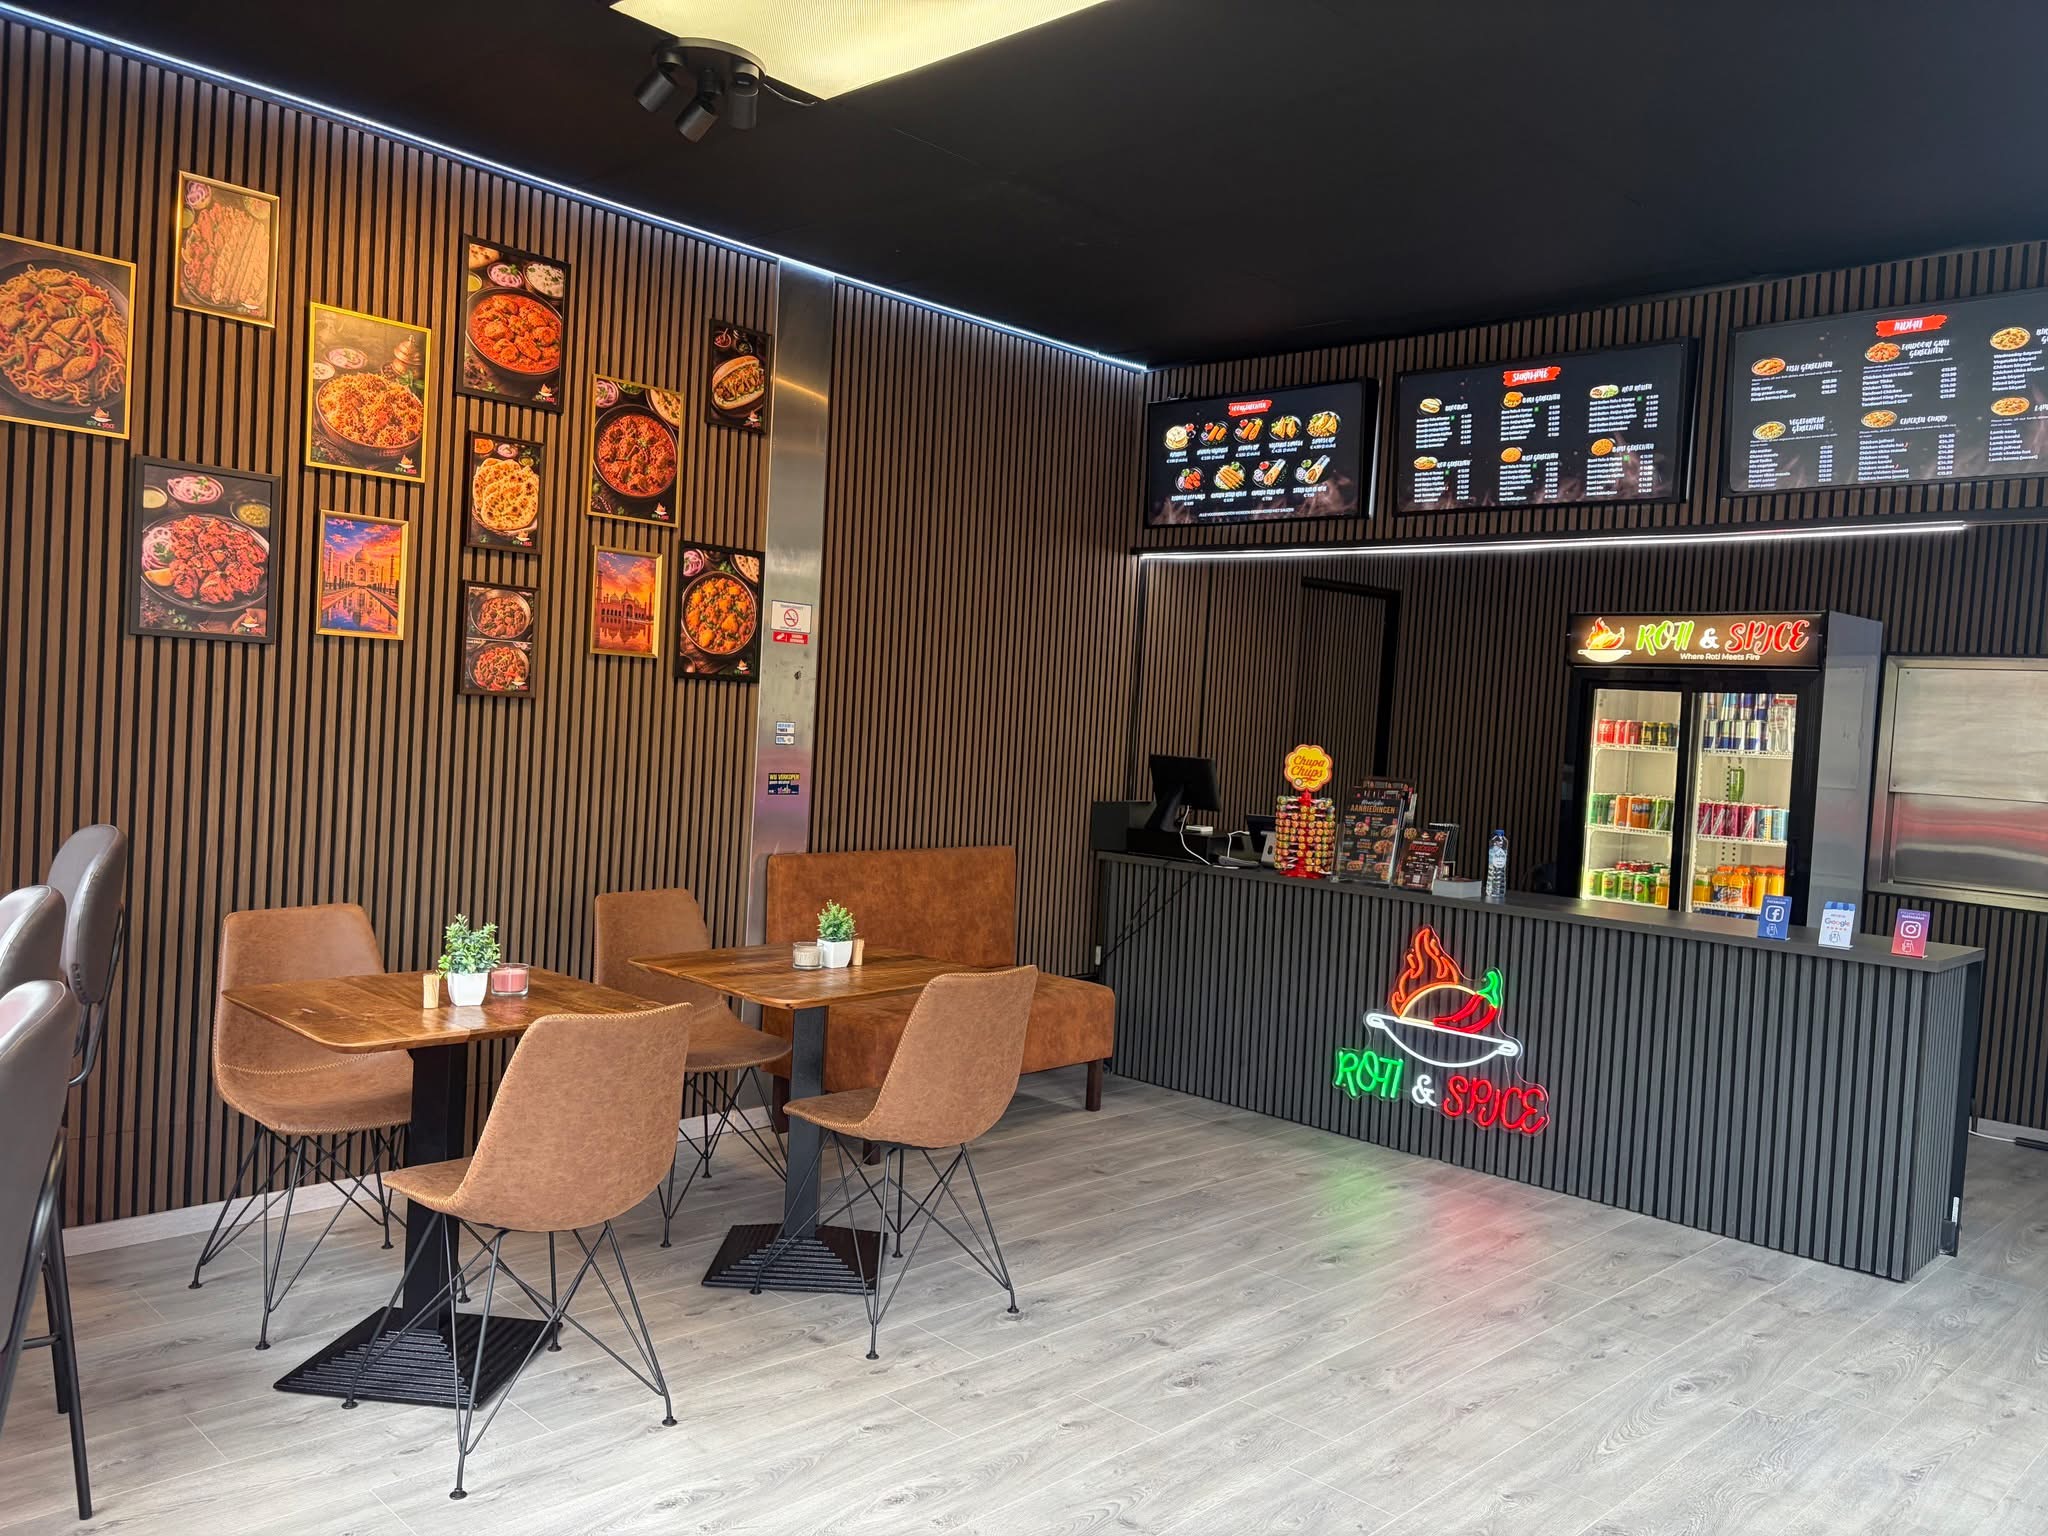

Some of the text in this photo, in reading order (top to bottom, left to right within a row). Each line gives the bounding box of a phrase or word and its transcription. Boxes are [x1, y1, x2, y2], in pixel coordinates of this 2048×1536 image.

[1800, 360, 1833, 372] GERECHTEN
[1636, 619, 1810, 656] ROTI & SPICE
[1293, 755, 1325, 768] Chupa
[1291, 766, 1322, 779] Chups
[1350, 804, 1395, 814] AANBIEDINGEN
[1825, 917, 1850, 927] Google
[1335, 1050, 1545, 1134] ROTI & SPICE
